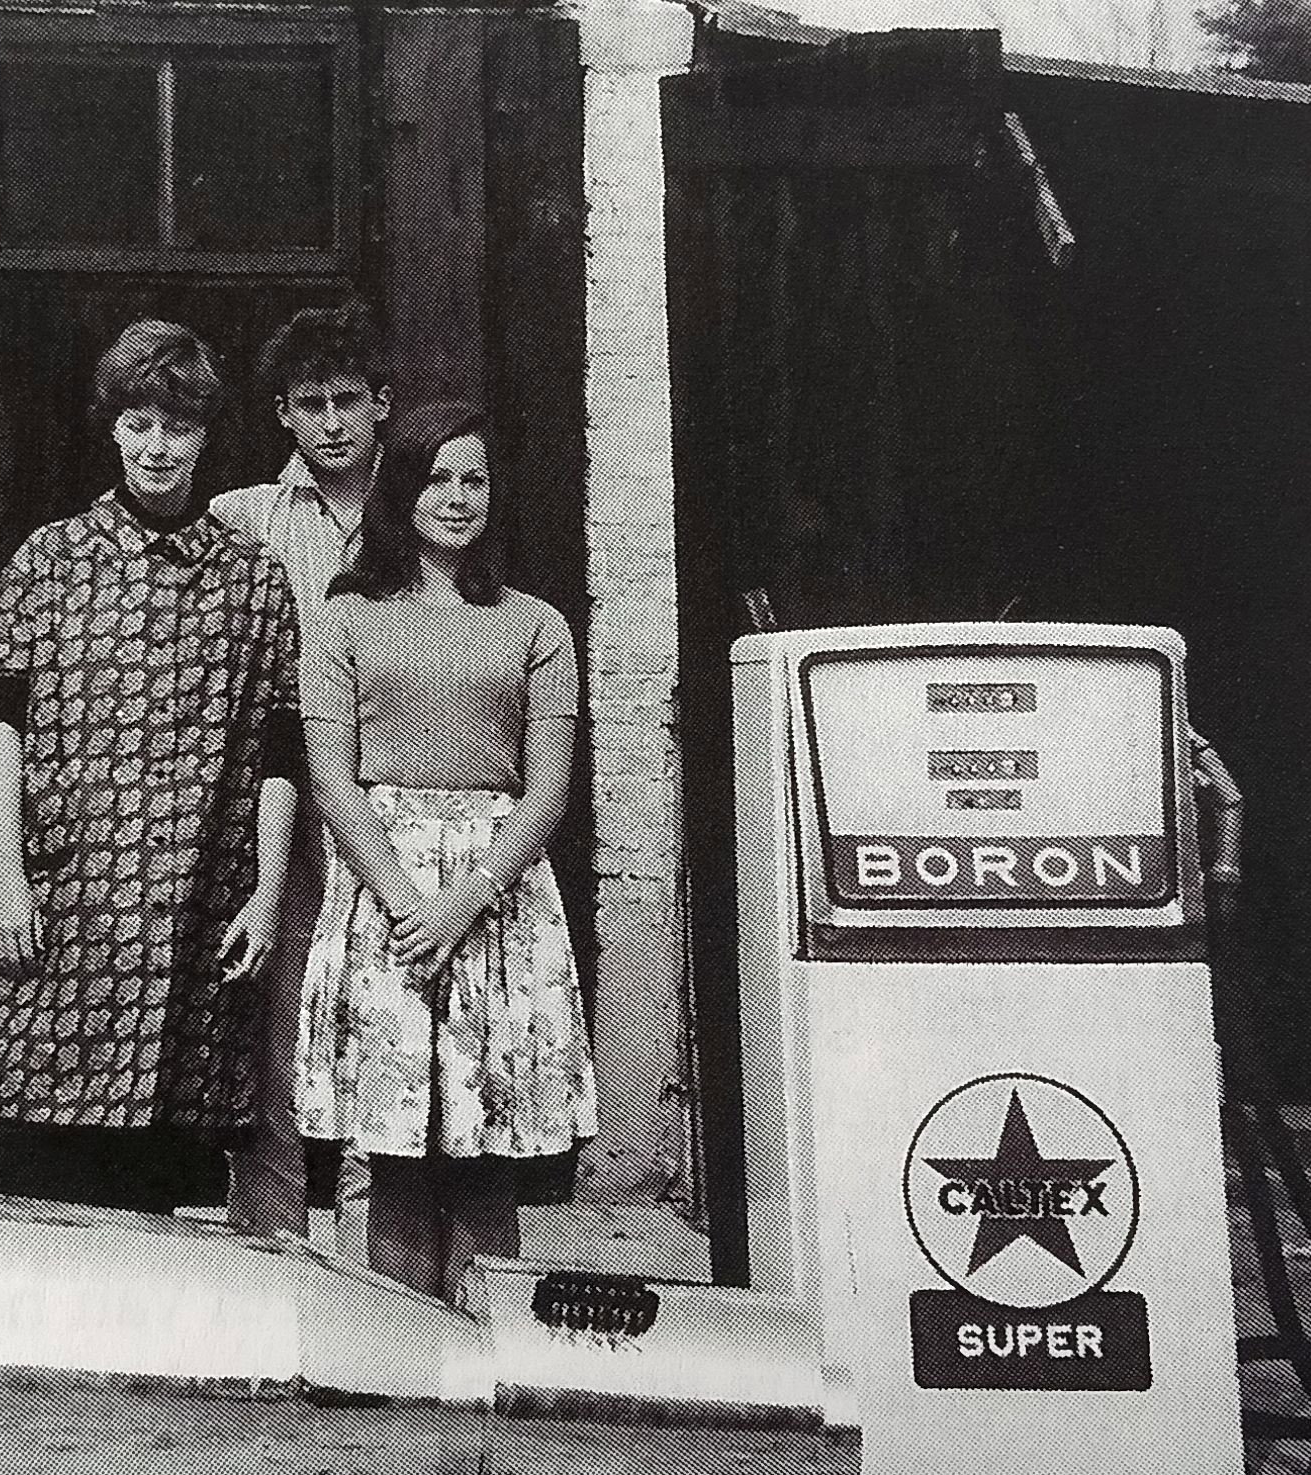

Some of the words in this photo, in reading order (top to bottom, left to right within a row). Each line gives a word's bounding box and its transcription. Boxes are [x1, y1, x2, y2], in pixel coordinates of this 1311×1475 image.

[856, 845, 1143, 887] BORON
[937, 1178, 1111, 1217] CALTEX
[957, 1323, 1104, 1358] SUPER
